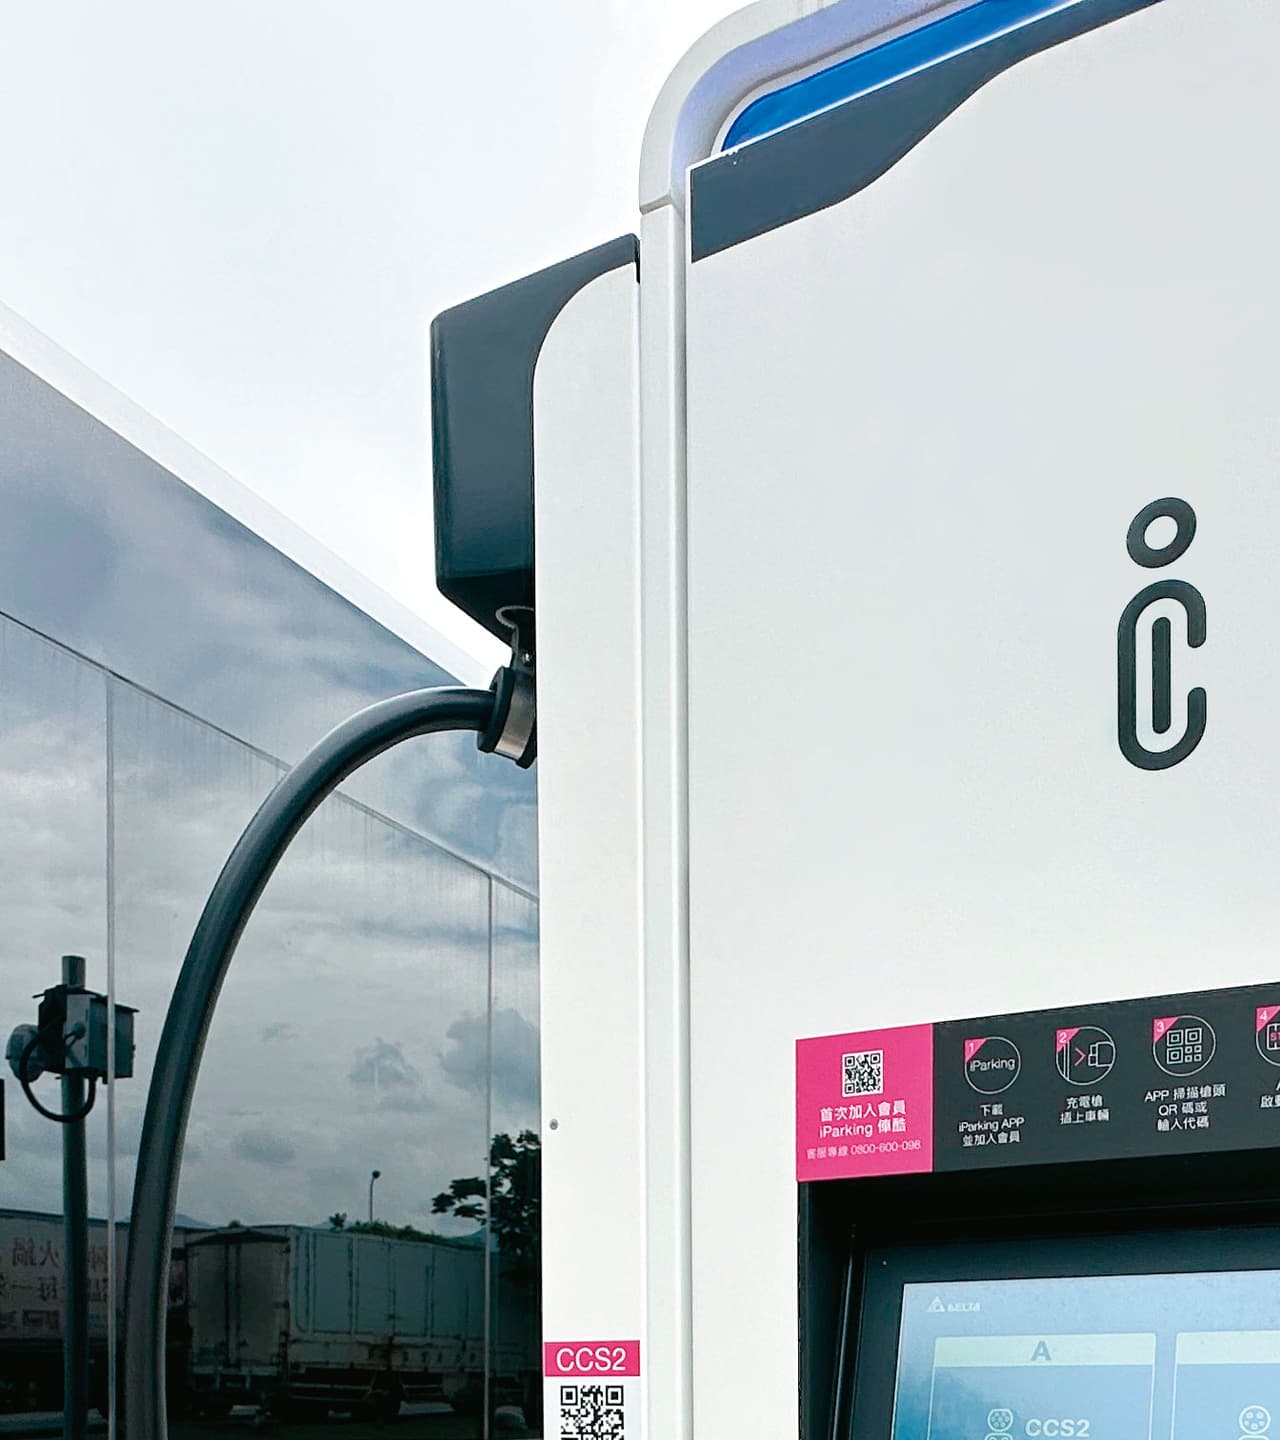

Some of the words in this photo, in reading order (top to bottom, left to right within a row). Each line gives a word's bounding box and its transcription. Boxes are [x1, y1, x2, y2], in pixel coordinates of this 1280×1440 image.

[1260, 1010, 1267, 1021] 4
[1156, 1021, 1164, 1033] 3
[1059, 1033, 1067, 1043] 2
[970, 1058, 1015, 1072] iParking
[1066, 1095, 1103, 1109] 充電槍
[1144, 1090, 1169, 1102] APP
[820, 1100, 906, 1122] 首次加入會員
[1158, 1104, 1178, 1116] QR
[819, 1123, 873, 1138] iParking
[958, 1120, 999, 1132] iParking
[1001, 1117, 1025, 1129] APP
[962, 1130, 1020, 1147] 並加入會員
[1030, 1340, 1052, 1362] A
[556, 1347, 627, 1372] CCS2
[1025, 1418, 1090, 1438] CCS2
